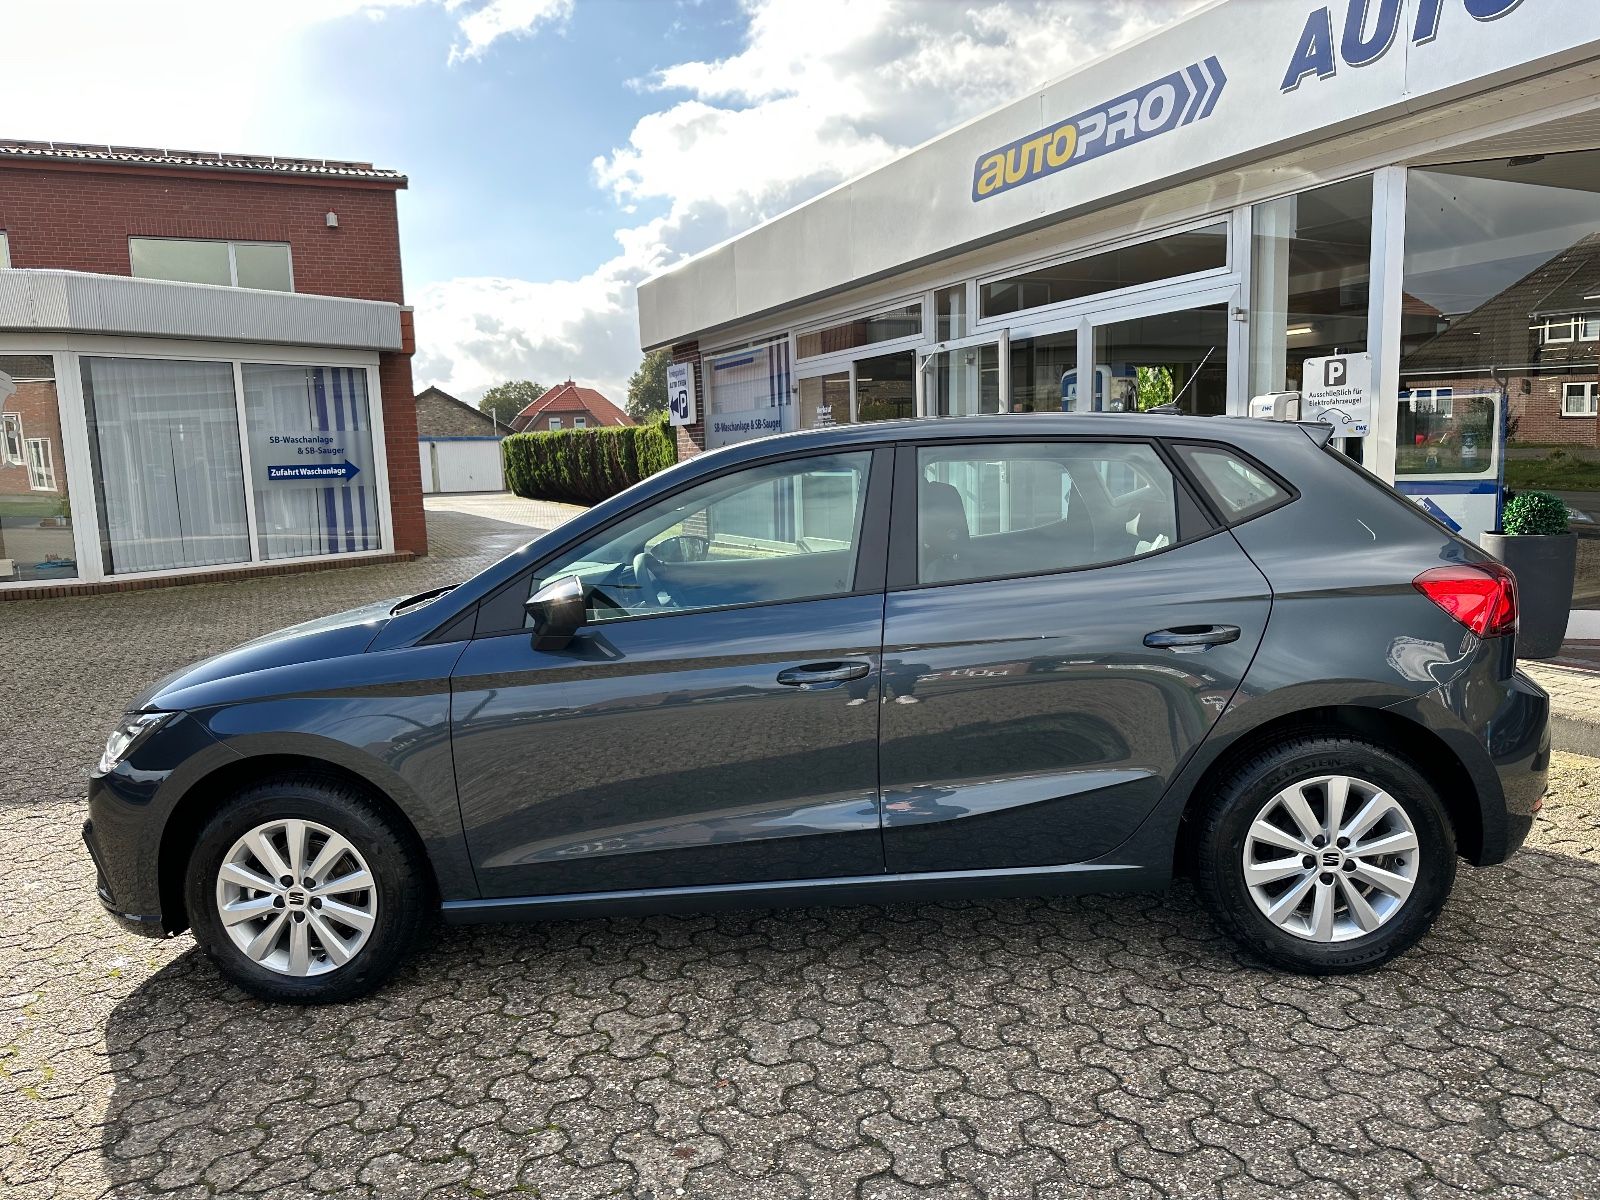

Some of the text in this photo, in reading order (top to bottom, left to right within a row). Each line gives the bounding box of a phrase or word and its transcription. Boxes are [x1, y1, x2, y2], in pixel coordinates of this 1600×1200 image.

[1308, 388, 1363, 399] Ausschließlich für
[713, 418, 782, 433] SB-Waschanlage & SB-Sauger
[269, 435, 334, 445] SB-Waschanlage
[297, 446, 345, 456] & SB-Sauger
[270, 466, 347, 477] Zufahrt Waschanlage
